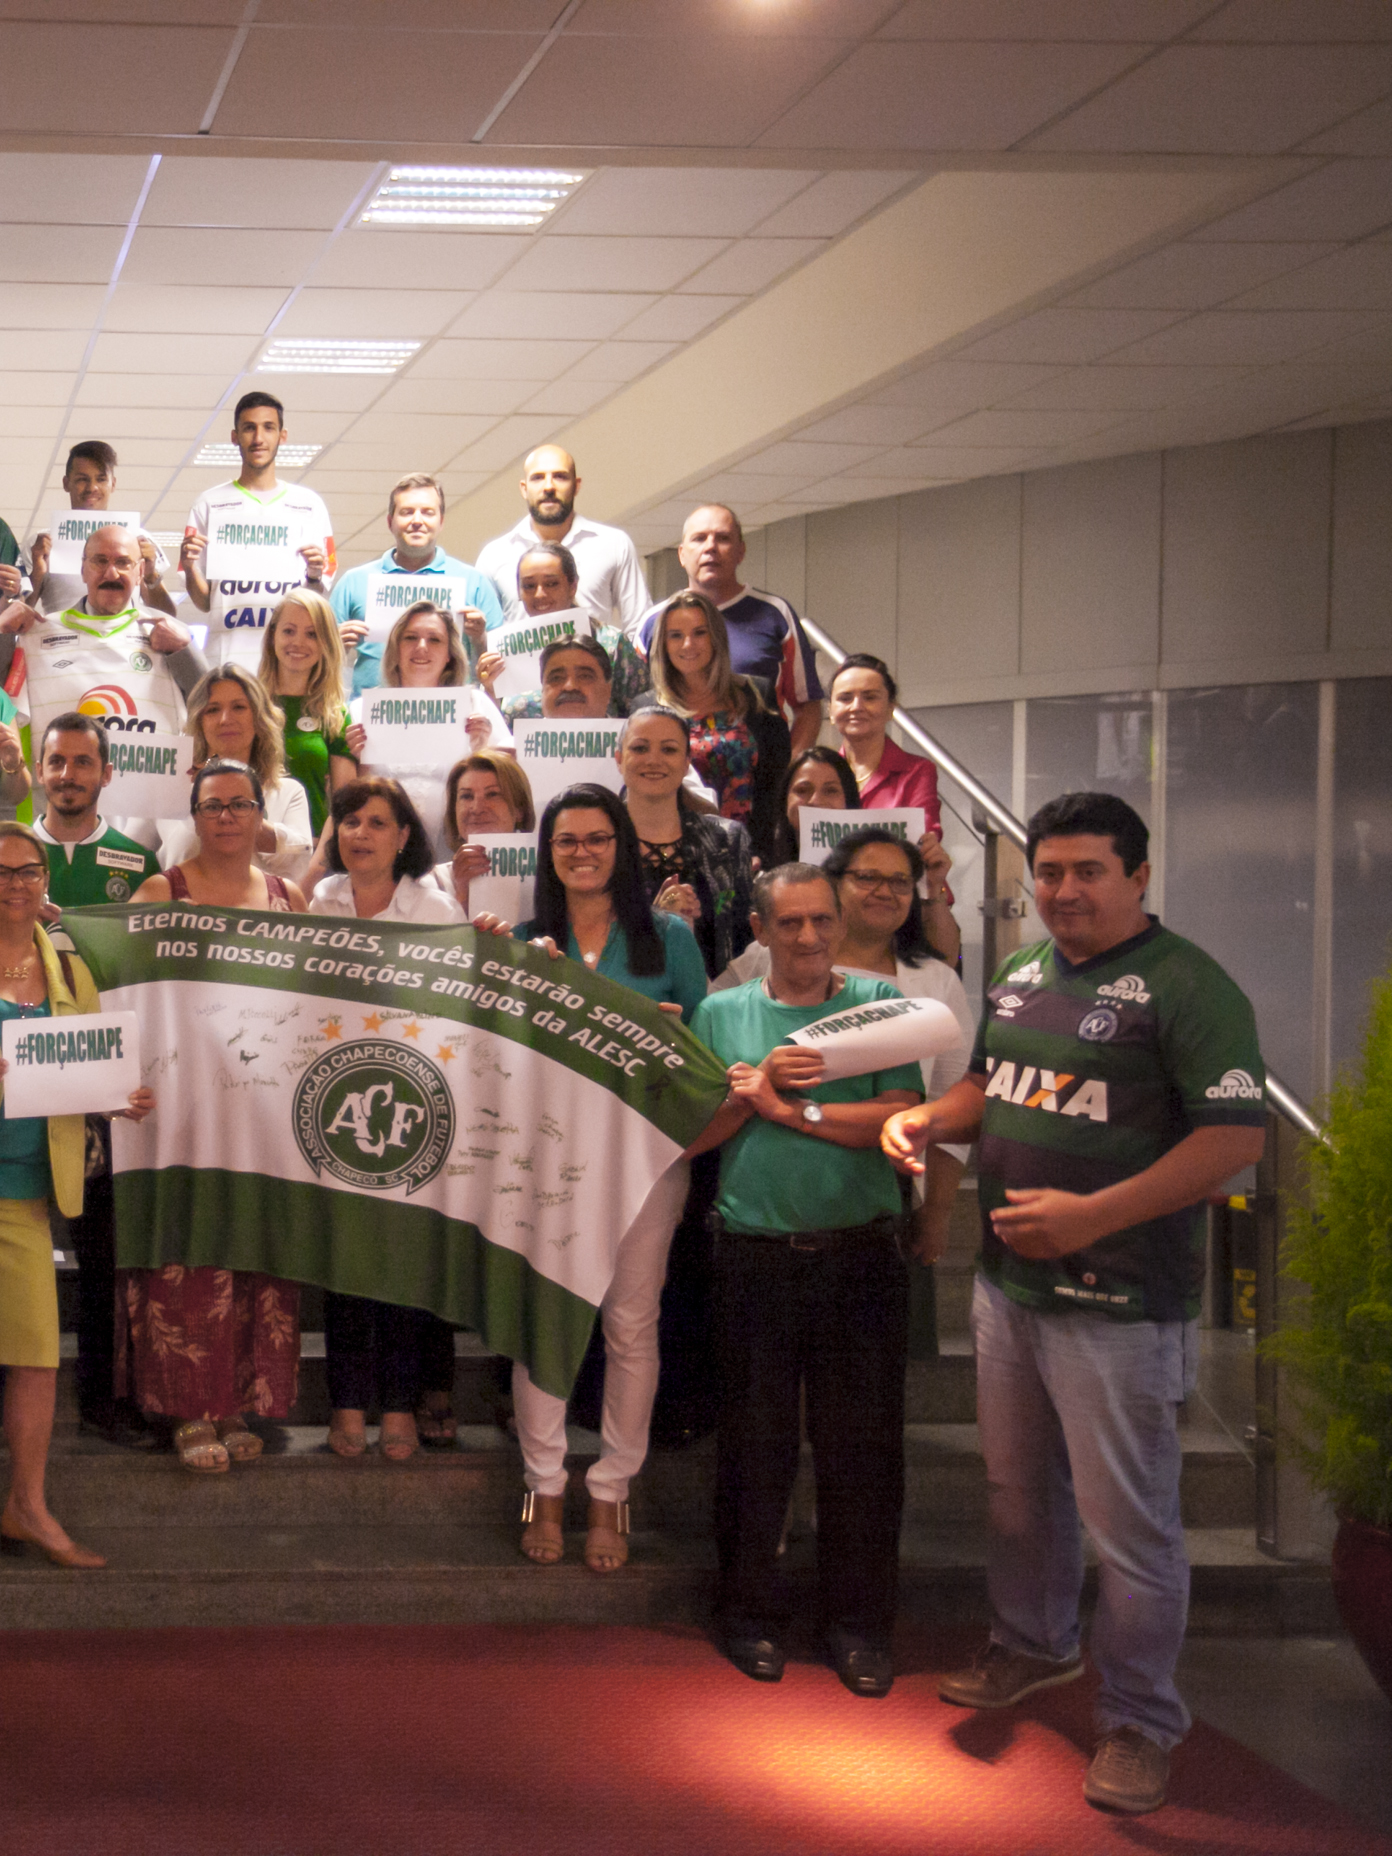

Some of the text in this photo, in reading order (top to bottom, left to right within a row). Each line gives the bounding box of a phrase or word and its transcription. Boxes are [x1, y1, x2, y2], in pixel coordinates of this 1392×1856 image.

[217, 524, 289, 550] #FORÇACHAPE
[224, 608, 274, 629] CAI
[371, 699, 456, 729] #FORÇACHAPE
[109, 743, 177, 777] RÇACHAPE
[128, 911, 685, 1069] Eternos CAMPEÕES, vocês estarão sempre
[1097, 983, 1151, 1004] aurora
[156, 941, 647, 1077] nos nossos corações amigos da ALESC
[804, 999, 924, 1040] #FORÇACHAPE
[15, 1027, 123, 1070] #FORÇACHAPE
[331, 1046, 441, 1092] CHAPECOENSE
[299, 1064, 332, 1158] ASSOCIAÇÃO
[433, 1094, 448, 1114] DE
[410, 1118, 448, 1178] FUTEBOL
[385, 1174, 398, 1183] SC
